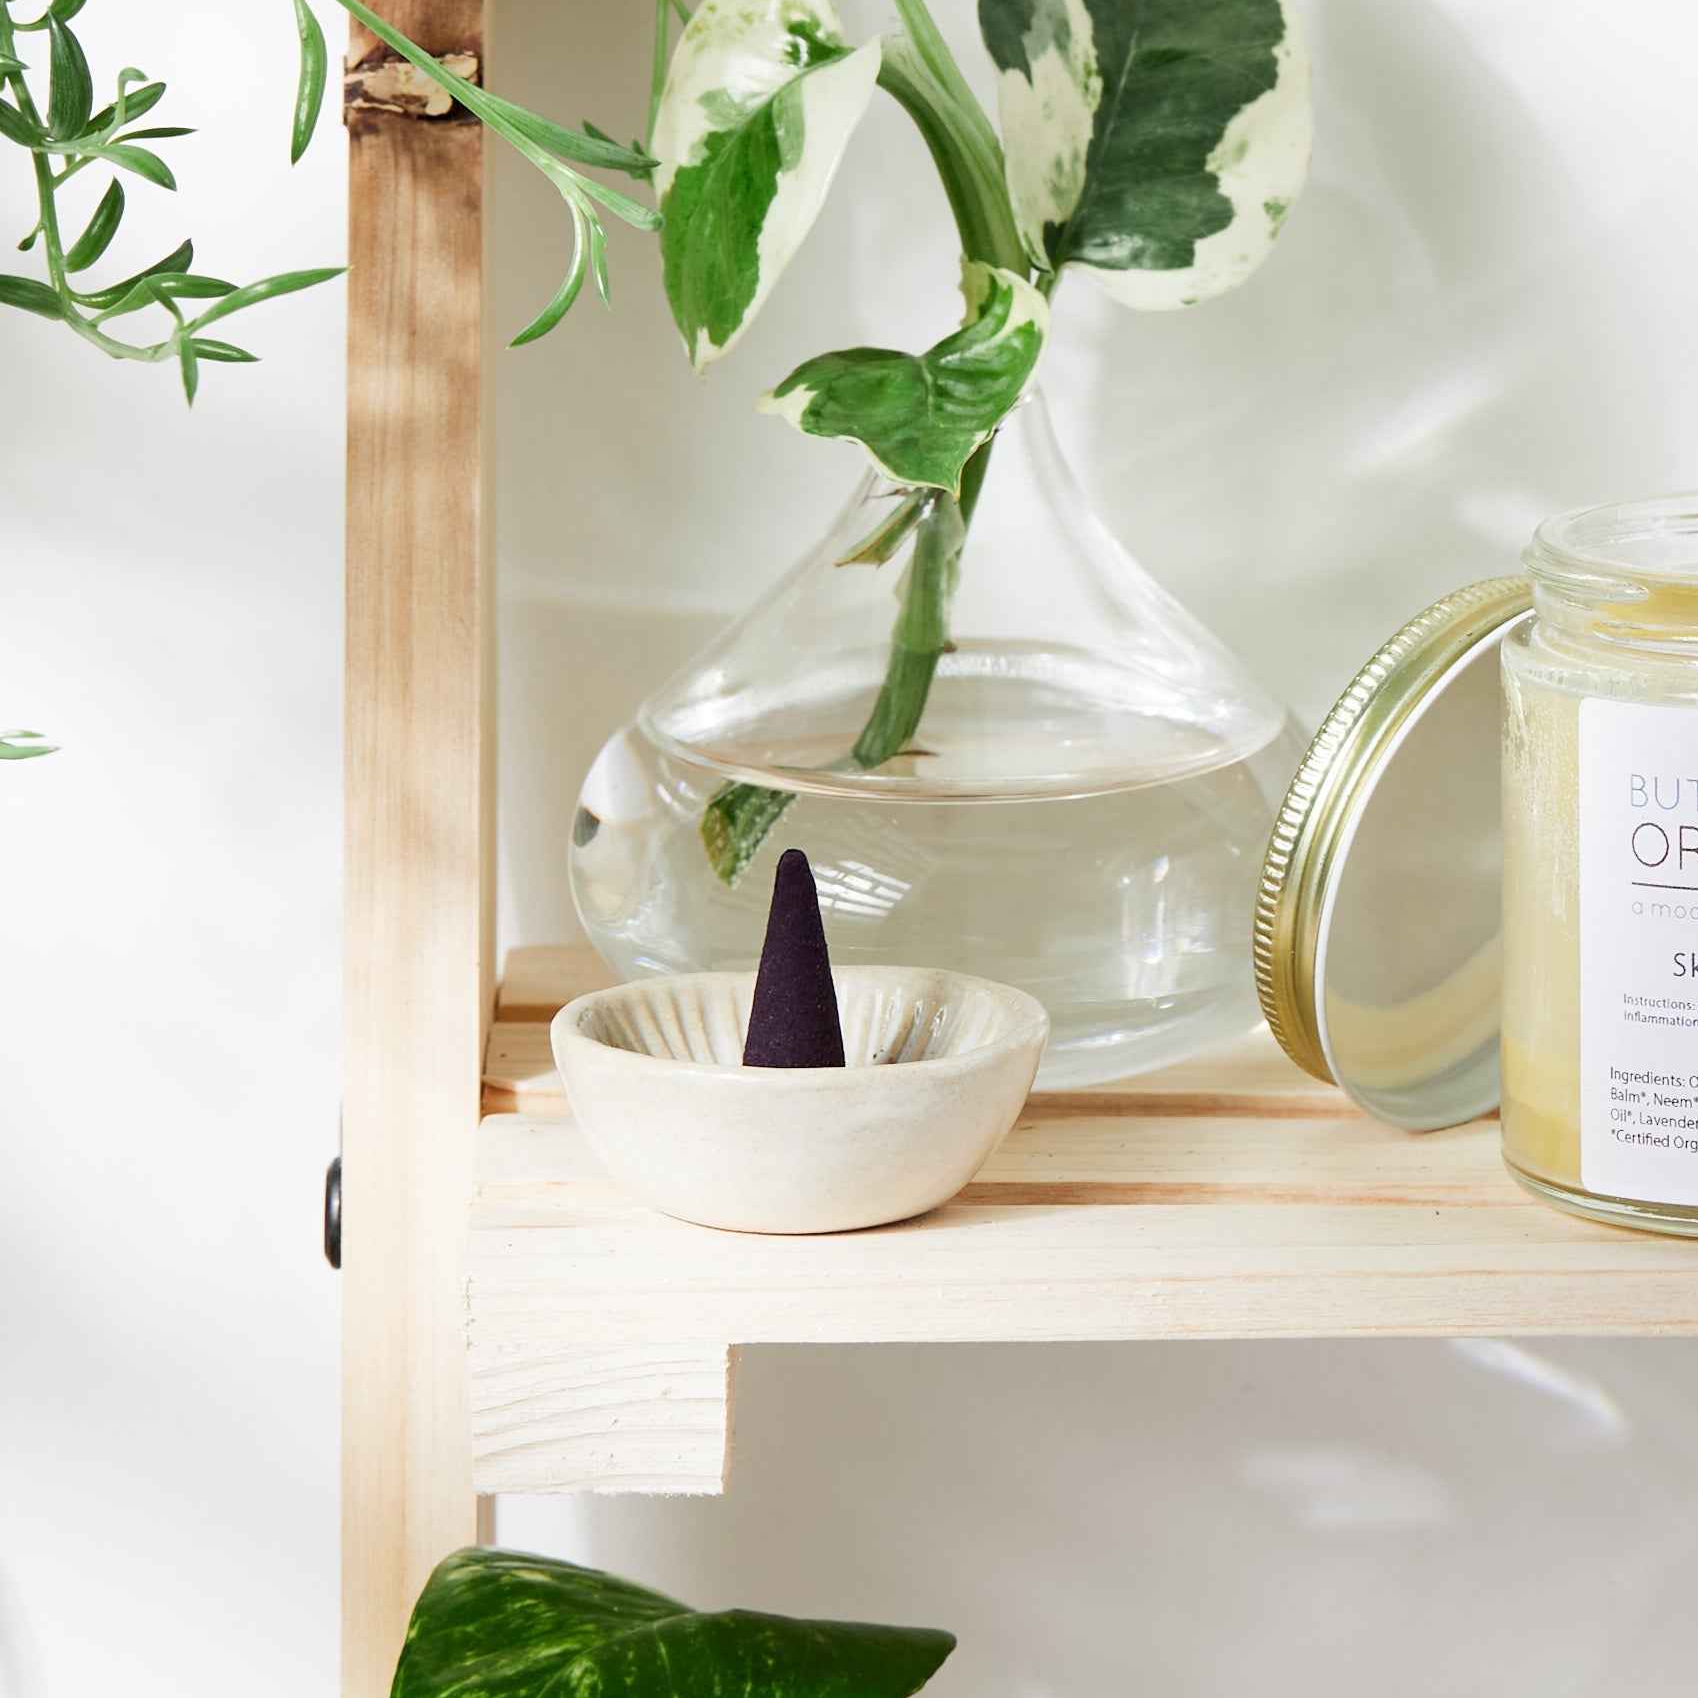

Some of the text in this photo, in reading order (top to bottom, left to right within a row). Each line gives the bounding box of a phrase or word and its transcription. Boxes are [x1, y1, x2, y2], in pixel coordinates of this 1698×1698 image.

[1631, 900, 1644, 916] a
[1623, 993, 1696, 1011] Instructions:
[1610, 1066, 1686, 1087] Ingredients:
